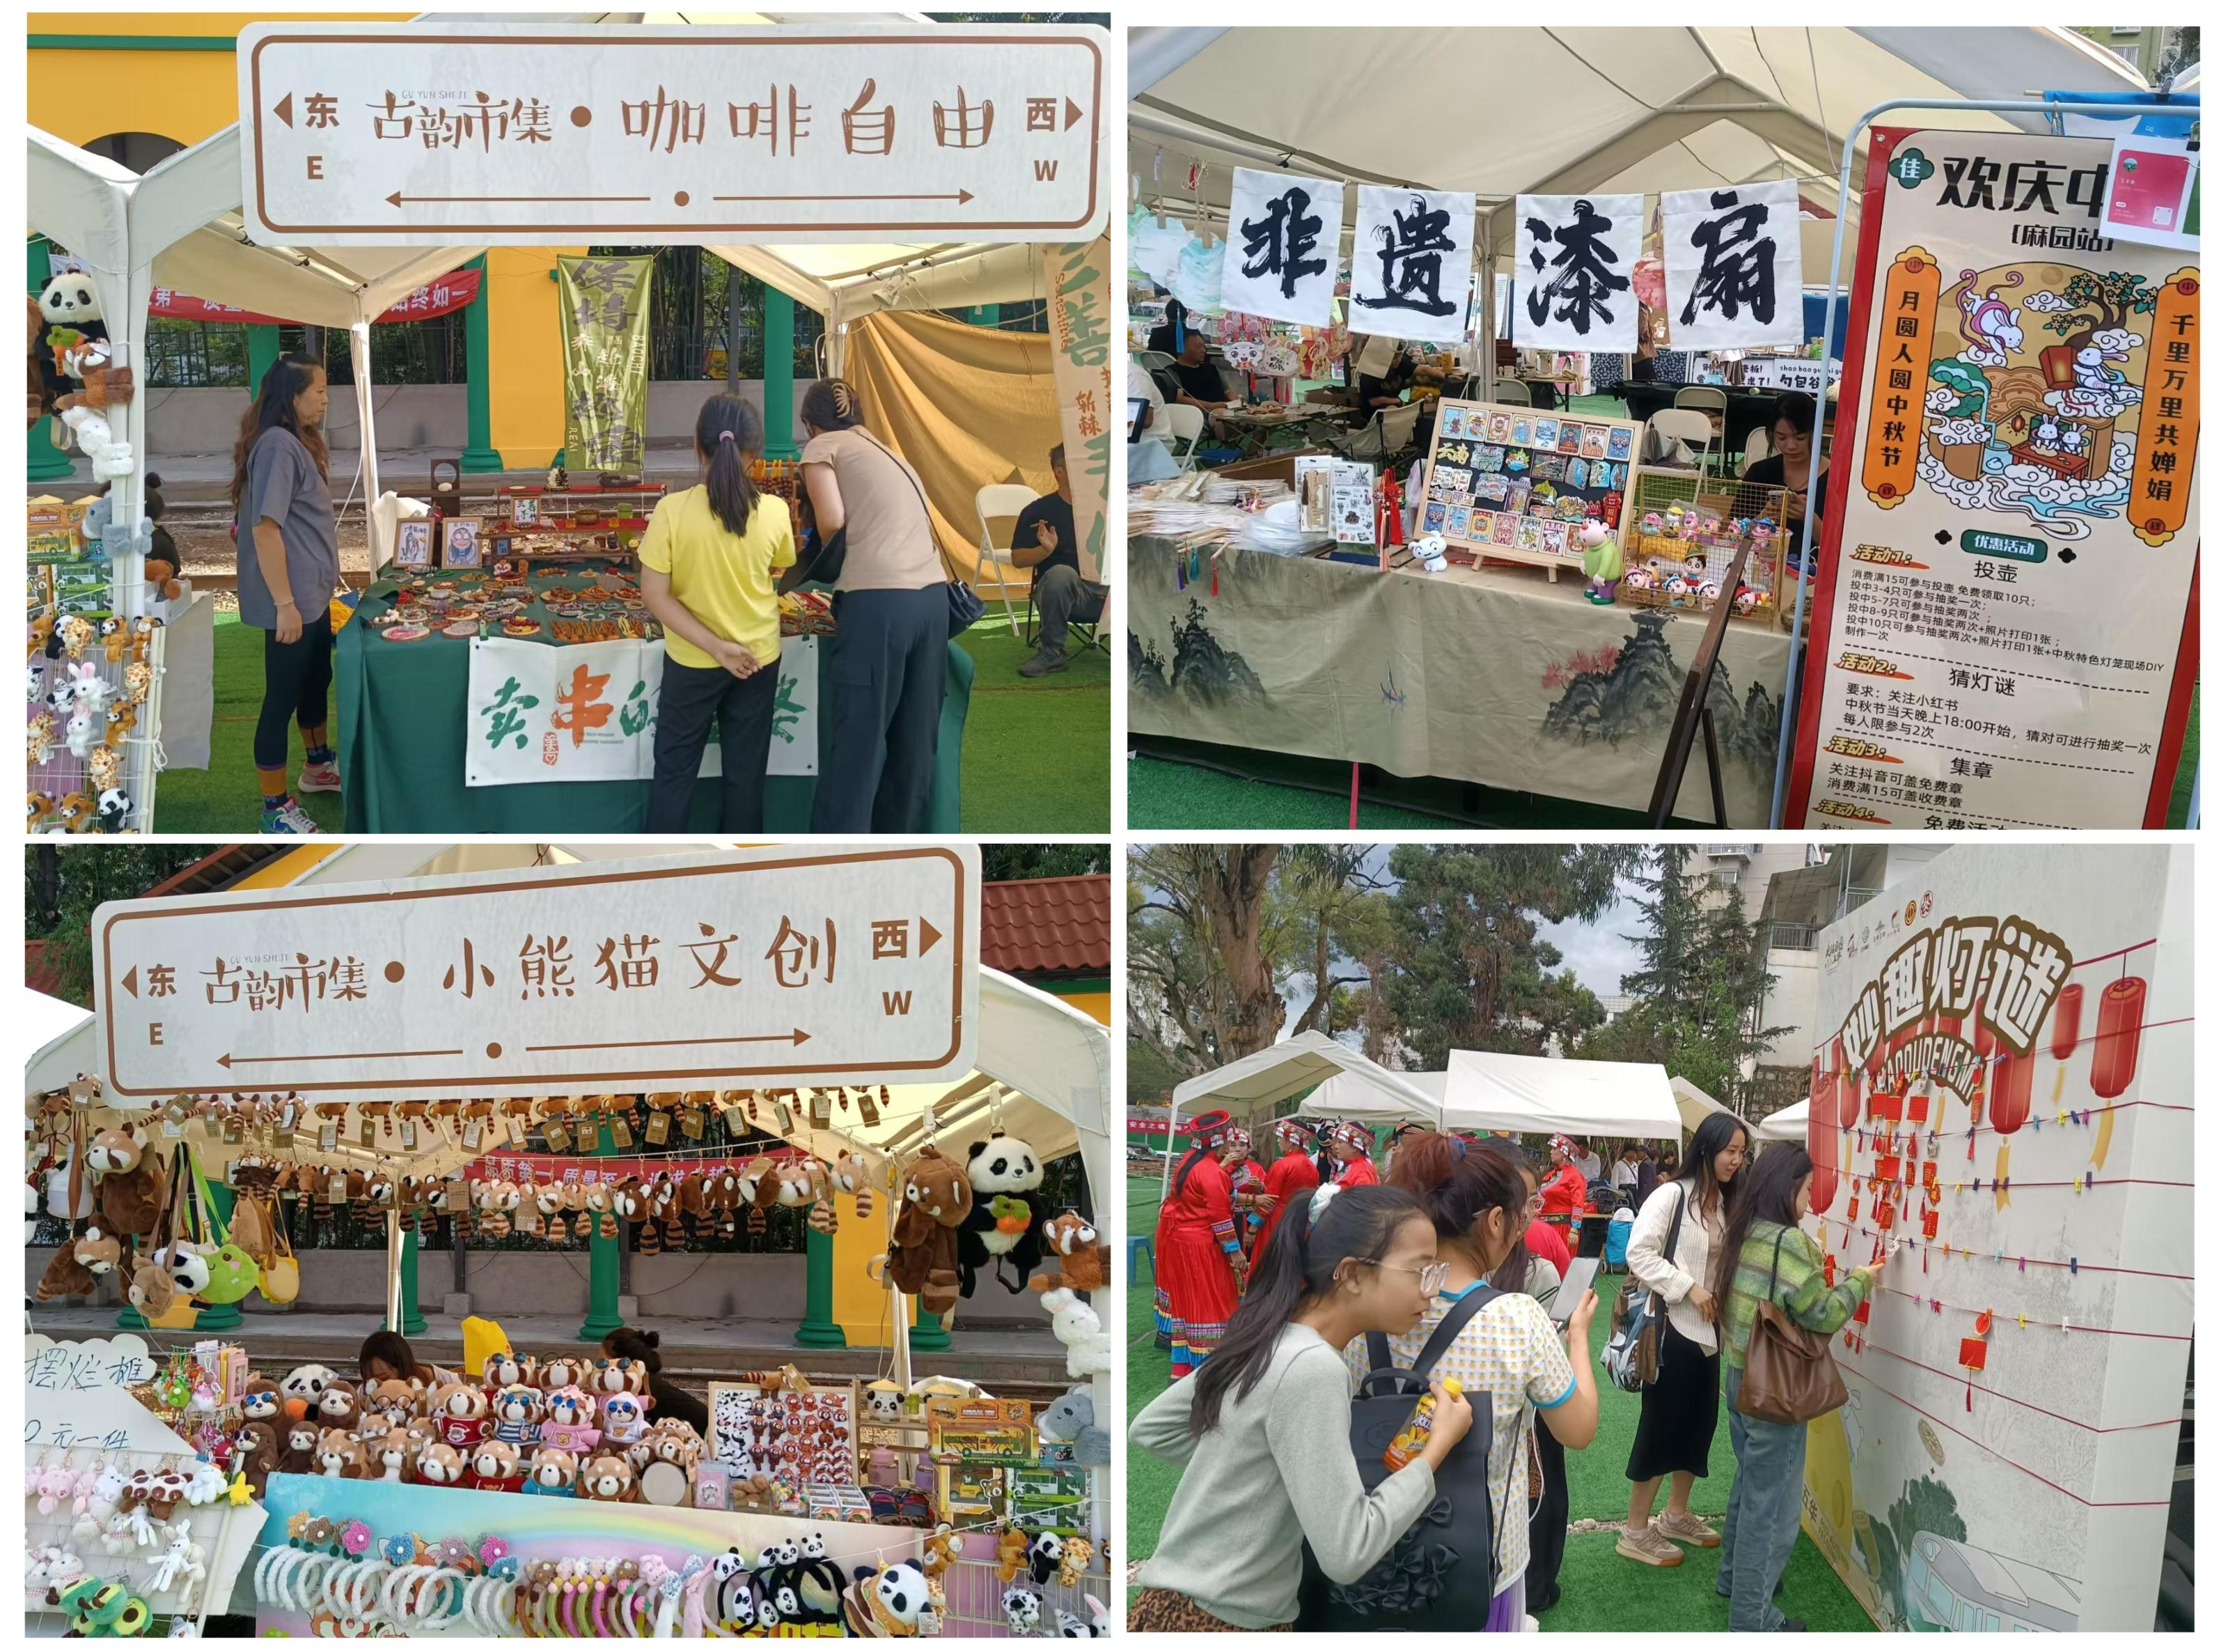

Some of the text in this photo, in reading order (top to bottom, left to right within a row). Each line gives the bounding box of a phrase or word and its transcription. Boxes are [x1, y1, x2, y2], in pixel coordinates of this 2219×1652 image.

[417, 90, 437, 100] YUN
[304, 92, 340, 129] 东
[365, 78, 994, 157] 古韵市集 咖啡自由
[1026, 97, 1058, 133] 西
[306, 155, 324, 180] E
[1033, 159, 1058, 182] W
[1899, 157, 1921, 179] 佳
[570, 259, 638, 332] 保持
[1880, 290, 1920, 468] 月圆人圆中秋节
[2145, 313, 2196, 502] 千里万里共婵娟
[1973, 533, 2036, 558] 优惠活动
[1851, 568, 1955, 594] 消费满15可参与投壶
[1974, 559, 2018, 584] 投壶
[1844, 625, 1890, 643] 制作一次
[1948, 668, 2016, 697] 猜灯谜
[1842, 712, 1935, 739] 每人限参与2次
[1828, 762, 1963, 795] 关注抖音可盖免费章
[1950, 756, 1995, 780] 集章
[1826, 776, 1963, 809] 消费满15可盖收费章
[870, 919, 909, 961] 西
[198, 914, 836, 1013] 古韵市集 小熊猫文创
[146, 963, 178, 998] 东
[882, 991, 913, 1016] W
[1842, 925, 2066, 1069] 妙趣灯谜
[149, 1022, 164, 1046] E
